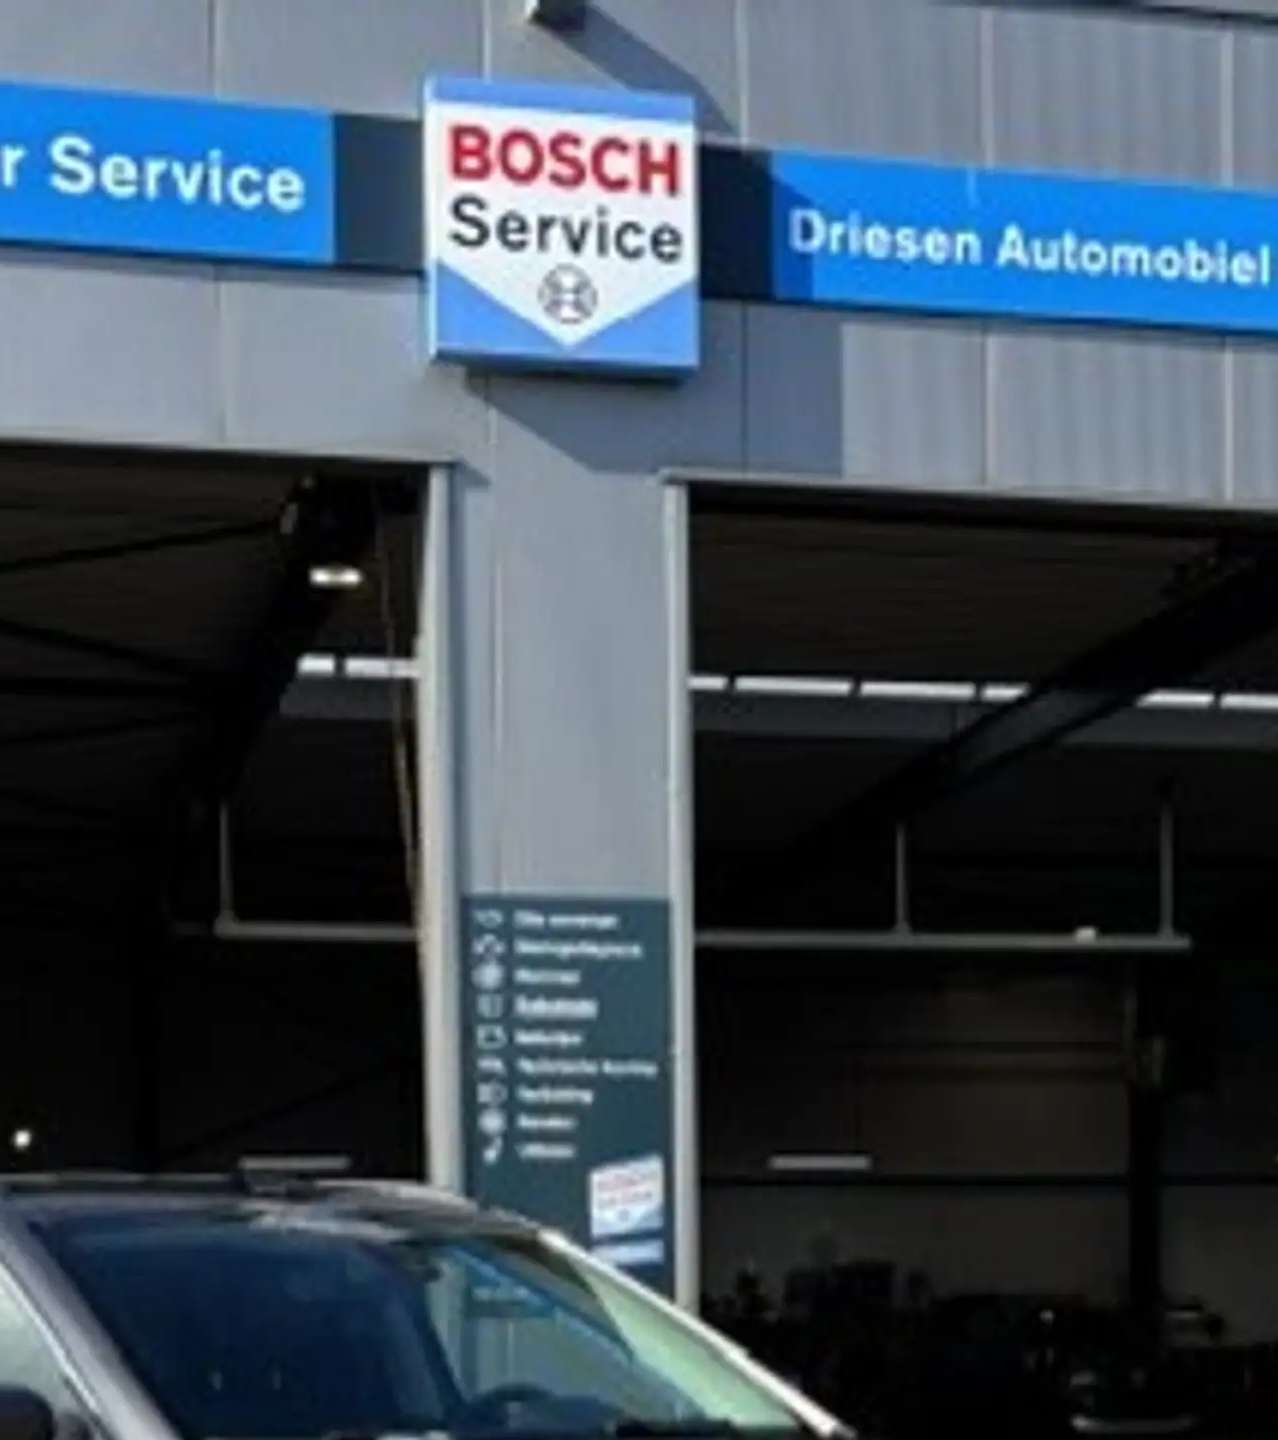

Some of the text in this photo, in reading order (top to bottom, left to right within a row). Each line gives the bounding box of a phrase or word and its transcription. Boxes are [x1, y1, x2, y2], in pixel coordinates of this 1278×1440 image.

[48, 136, 305, 212] Service
[447, 124, 681, 195] BOSCH
[449, 194, 684, 262] Service
[787, 207, 982, 264] Driesen
[996, 224, 1272, 286] Automobiel
